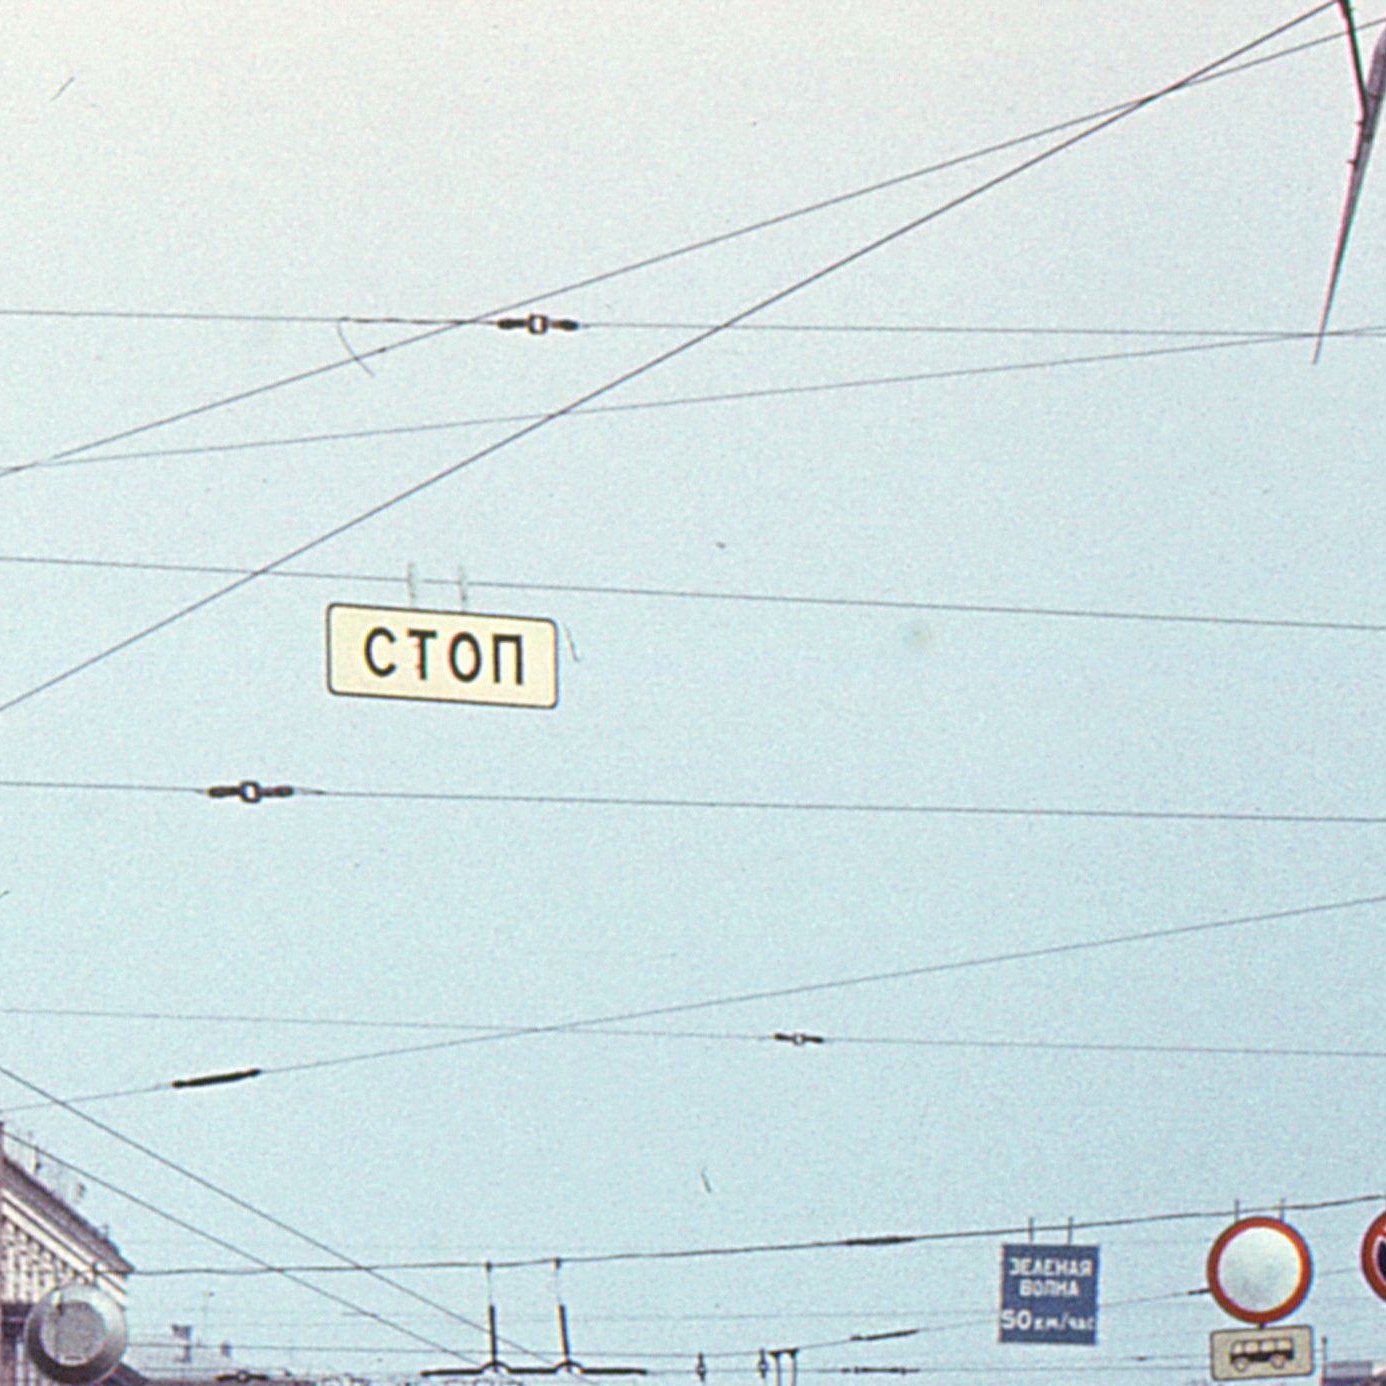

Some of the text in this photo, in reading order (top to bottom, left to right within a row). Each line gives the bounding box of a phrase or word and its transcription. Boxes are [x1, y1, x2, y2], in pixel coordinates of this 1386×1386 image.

[364, 627, 523, 686] СТОП
[1009, 1257, 1094, 1276] ЗЕЛЕНАЯ
[1019, 1279, 1080, 1297] ВОЛНА
[1001, 1308, 1032, 1331] 50
